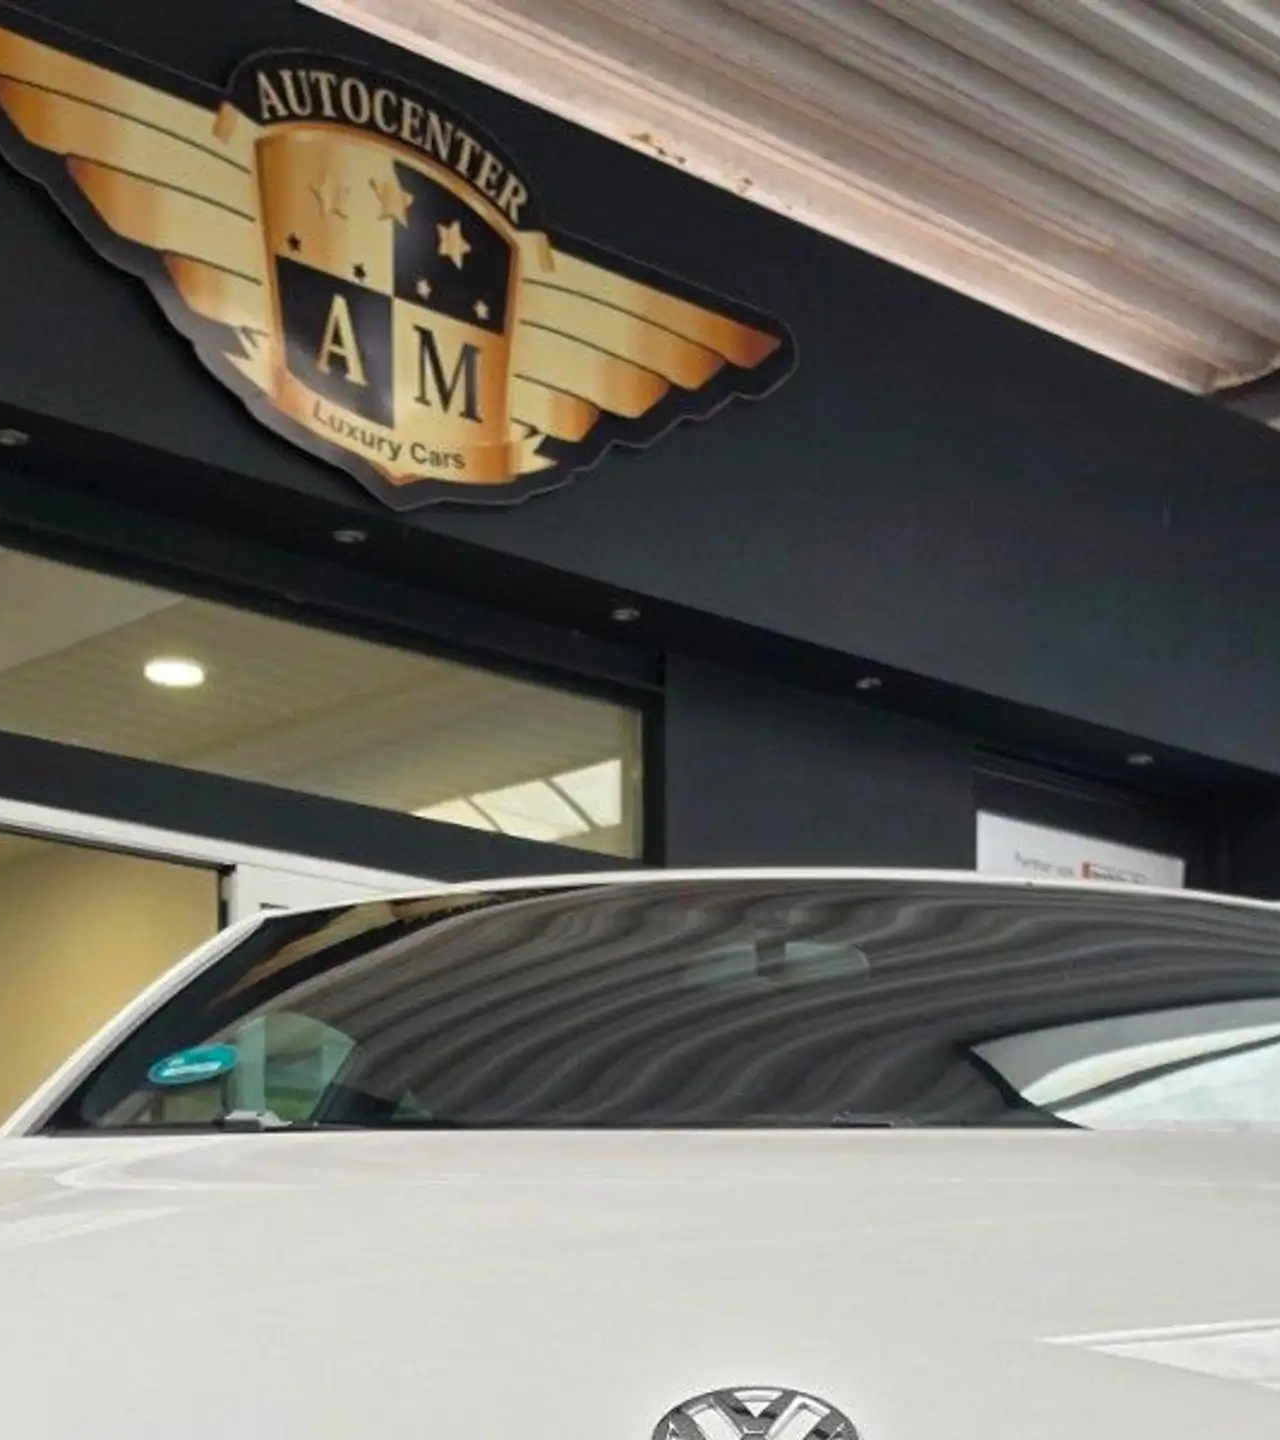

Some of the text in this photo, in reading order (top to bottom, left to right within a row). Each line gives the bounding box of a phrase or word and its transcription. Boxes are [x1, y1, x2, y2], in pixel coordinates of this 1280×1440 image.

[256, 68, 528, 224] AUTOCENTER
[312, 400, 467, 470] Luxury Cars
